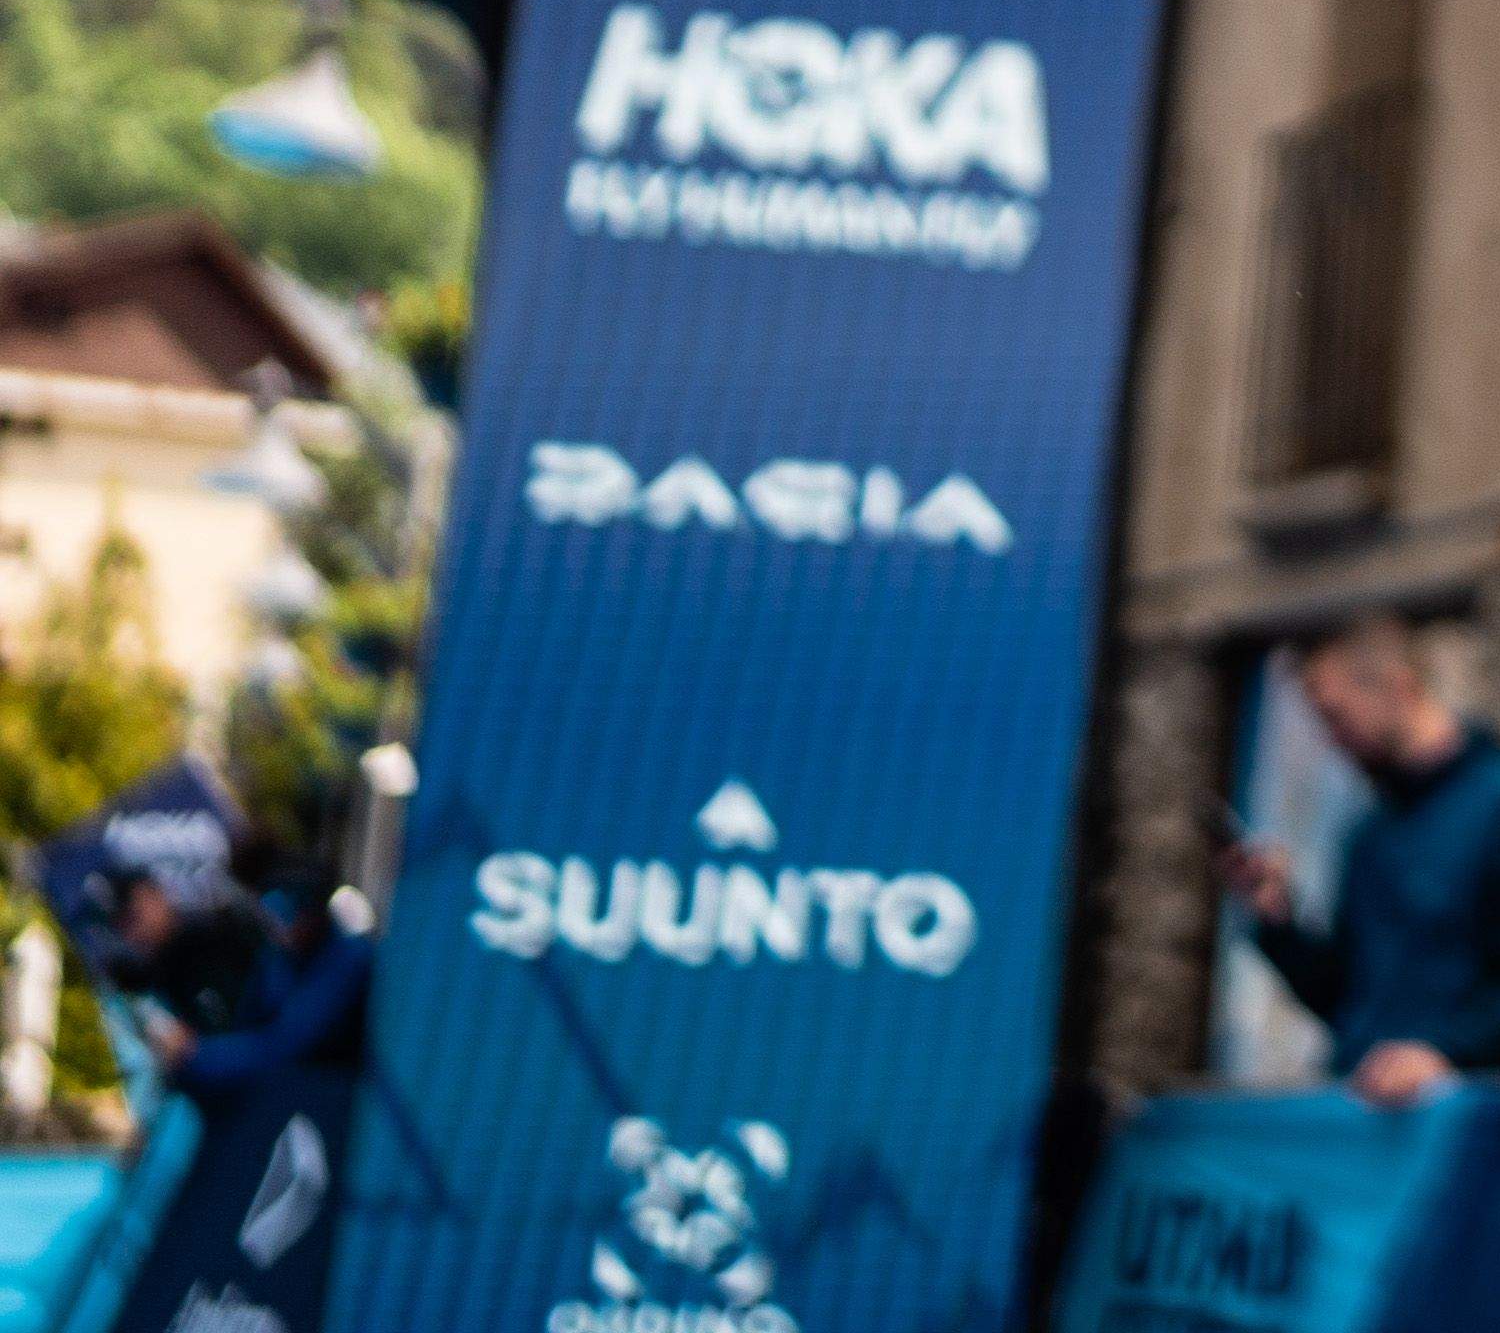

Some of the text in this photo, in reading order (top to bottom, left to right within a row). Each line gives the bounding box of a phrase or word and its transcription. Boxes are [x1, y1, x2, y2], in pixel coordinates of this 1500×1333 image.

[576, 1, 1050, 197] HOKA
[525, 439, 1014, 556] DACIA
[469, 851, 981, 978] SUUNTO
